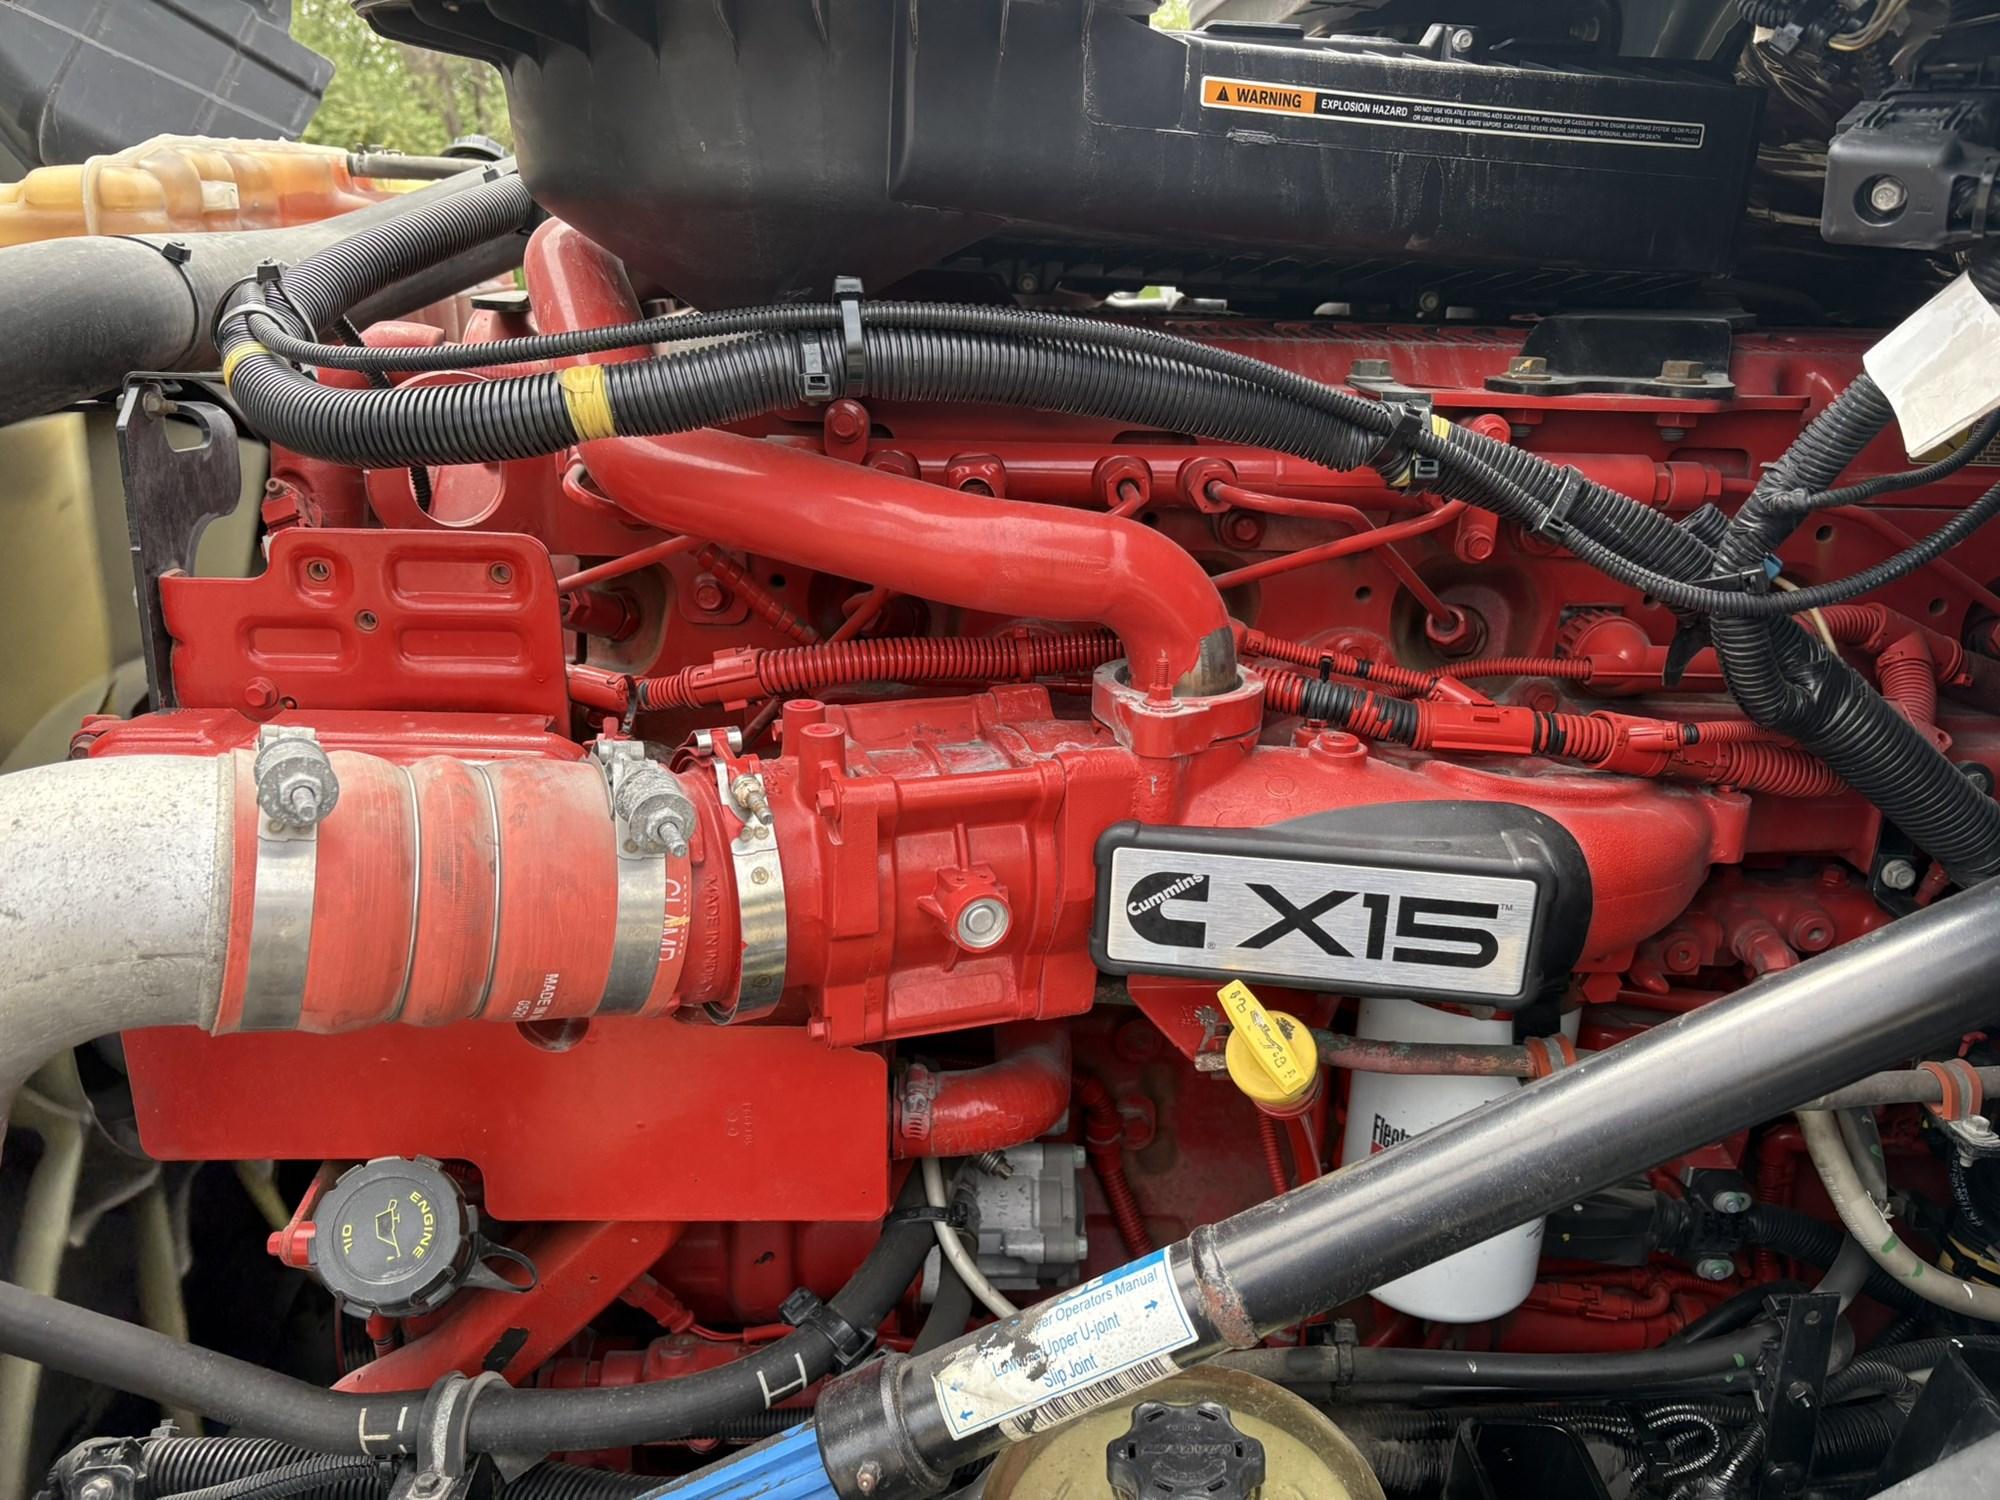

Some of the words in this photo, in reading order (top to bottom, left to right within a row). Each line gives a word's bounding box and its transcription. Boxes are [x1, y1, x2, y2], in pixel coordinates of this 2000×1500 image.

[1237, 88, 1301, 108] WARNING
[1321, 99, 1370, 113] EXPLOSION
[1372, 104, 1408, 117] HAZARD
[1126, 872, 1206, 917] Cummins
[1235, 882, 1499, 969] X15
[537, 973, 560, 1006] MADE
[342, 1224, 353, 1255] OIL
[409, 1191, 434, 1259] ENGINE
[1055, 1291, 1113, 1322] Operators
[1115, 1267, 1159, 1297] Manual
[1043, 1331, 1079, 1357] Upper
[1080, 1312, 1121, 1341] U-joint
[1043, 1367, 1068, 1388] Slip
[1069, 1353, 1098, 1378] Joint
